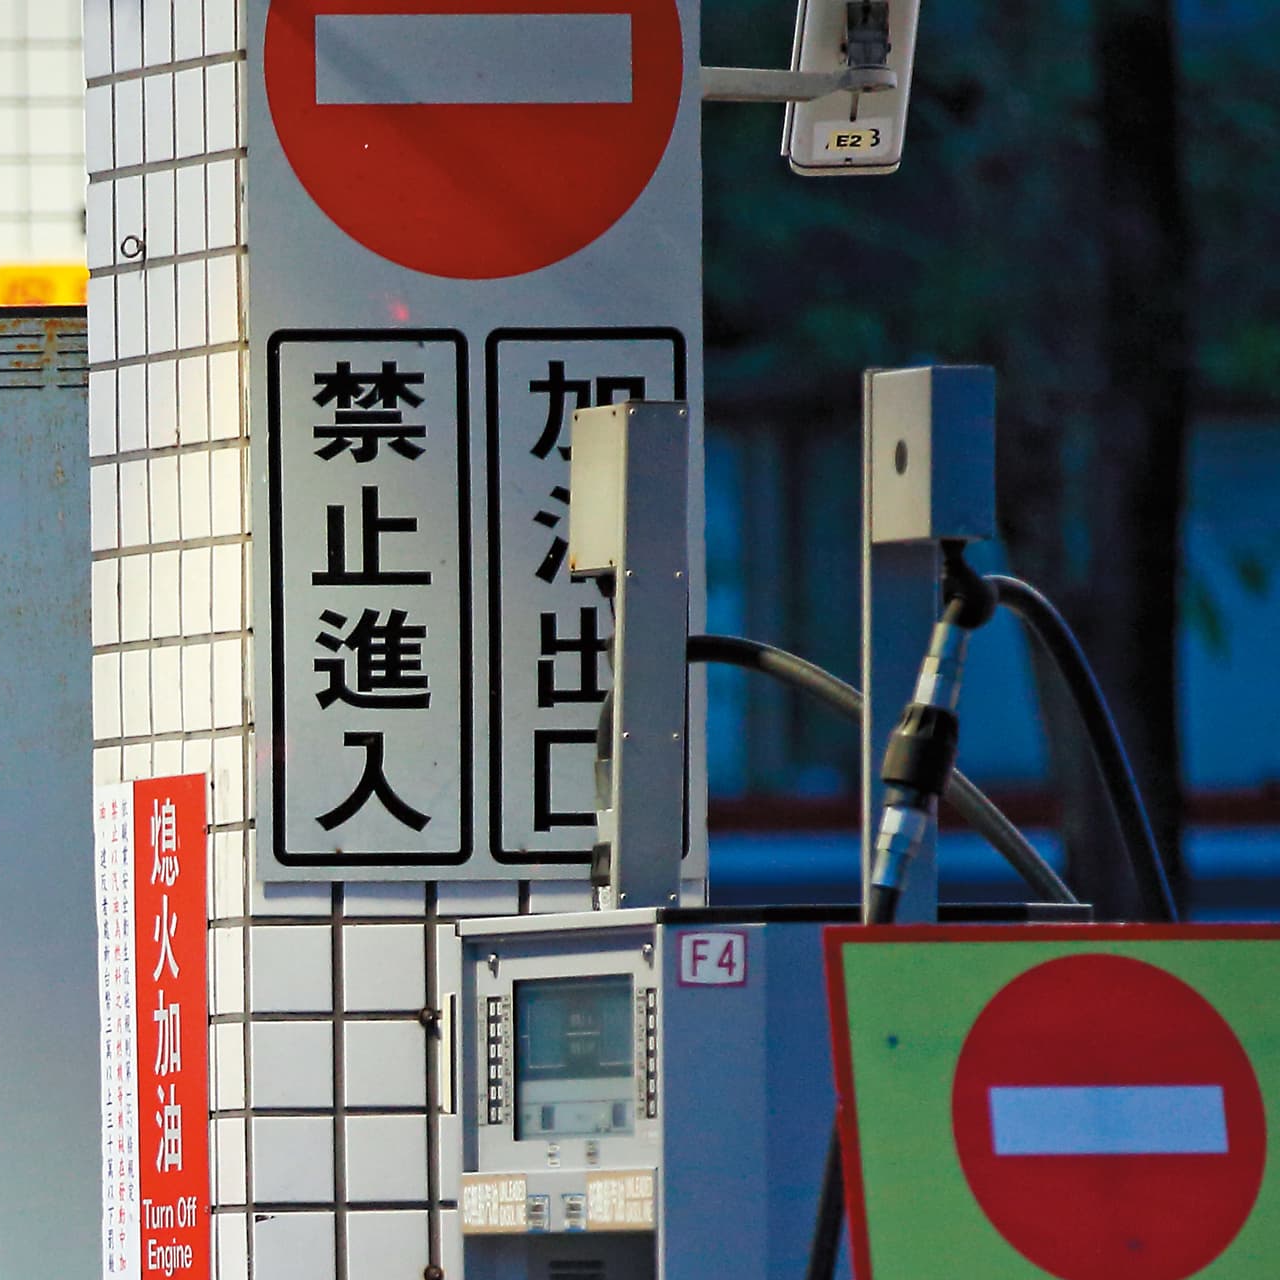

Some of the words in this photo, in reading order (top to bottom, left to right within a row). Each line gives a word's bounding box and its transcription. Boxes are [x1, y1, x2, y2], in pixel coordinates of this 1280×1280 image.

[835, 134, 862, 148] E2
[312, 360, 432, 833] 禁止進入
[529, 360, 646, 833] 加出口
[692, 938, 738, 978] F4
[150, 797, 183, 1173] 熄火加油
[143, 1198, 174, 1230] Turn
[177, 1196, 197, 1226] Off
[147, 1237, 193, 1272] Engine
